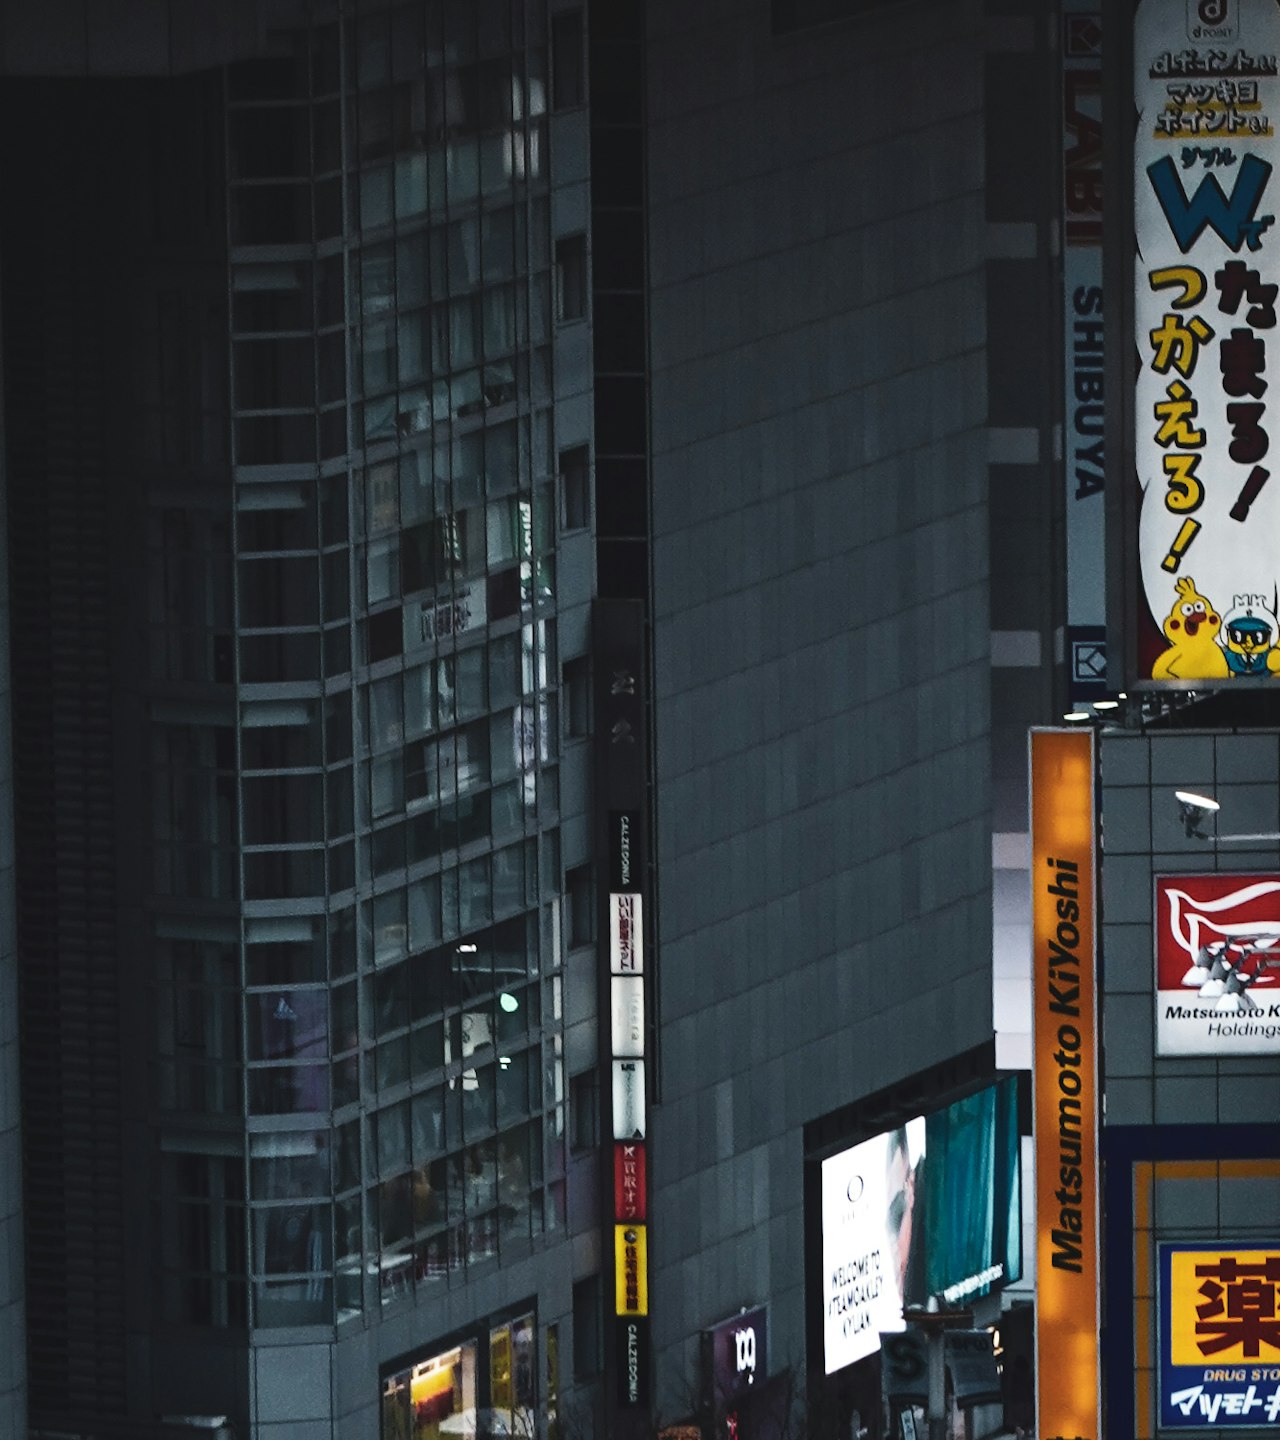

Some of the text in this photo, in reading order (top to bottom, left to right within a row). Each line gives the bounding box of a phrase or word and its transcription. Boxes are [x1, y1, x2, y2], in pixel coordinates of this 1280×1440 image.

[1073, 284, 1107, 502] SHIBUYA
[1046, 857, 1084, 1274] Matsumoto KiYoshi
[1203, 1368, 1247, 1383] DRUG
